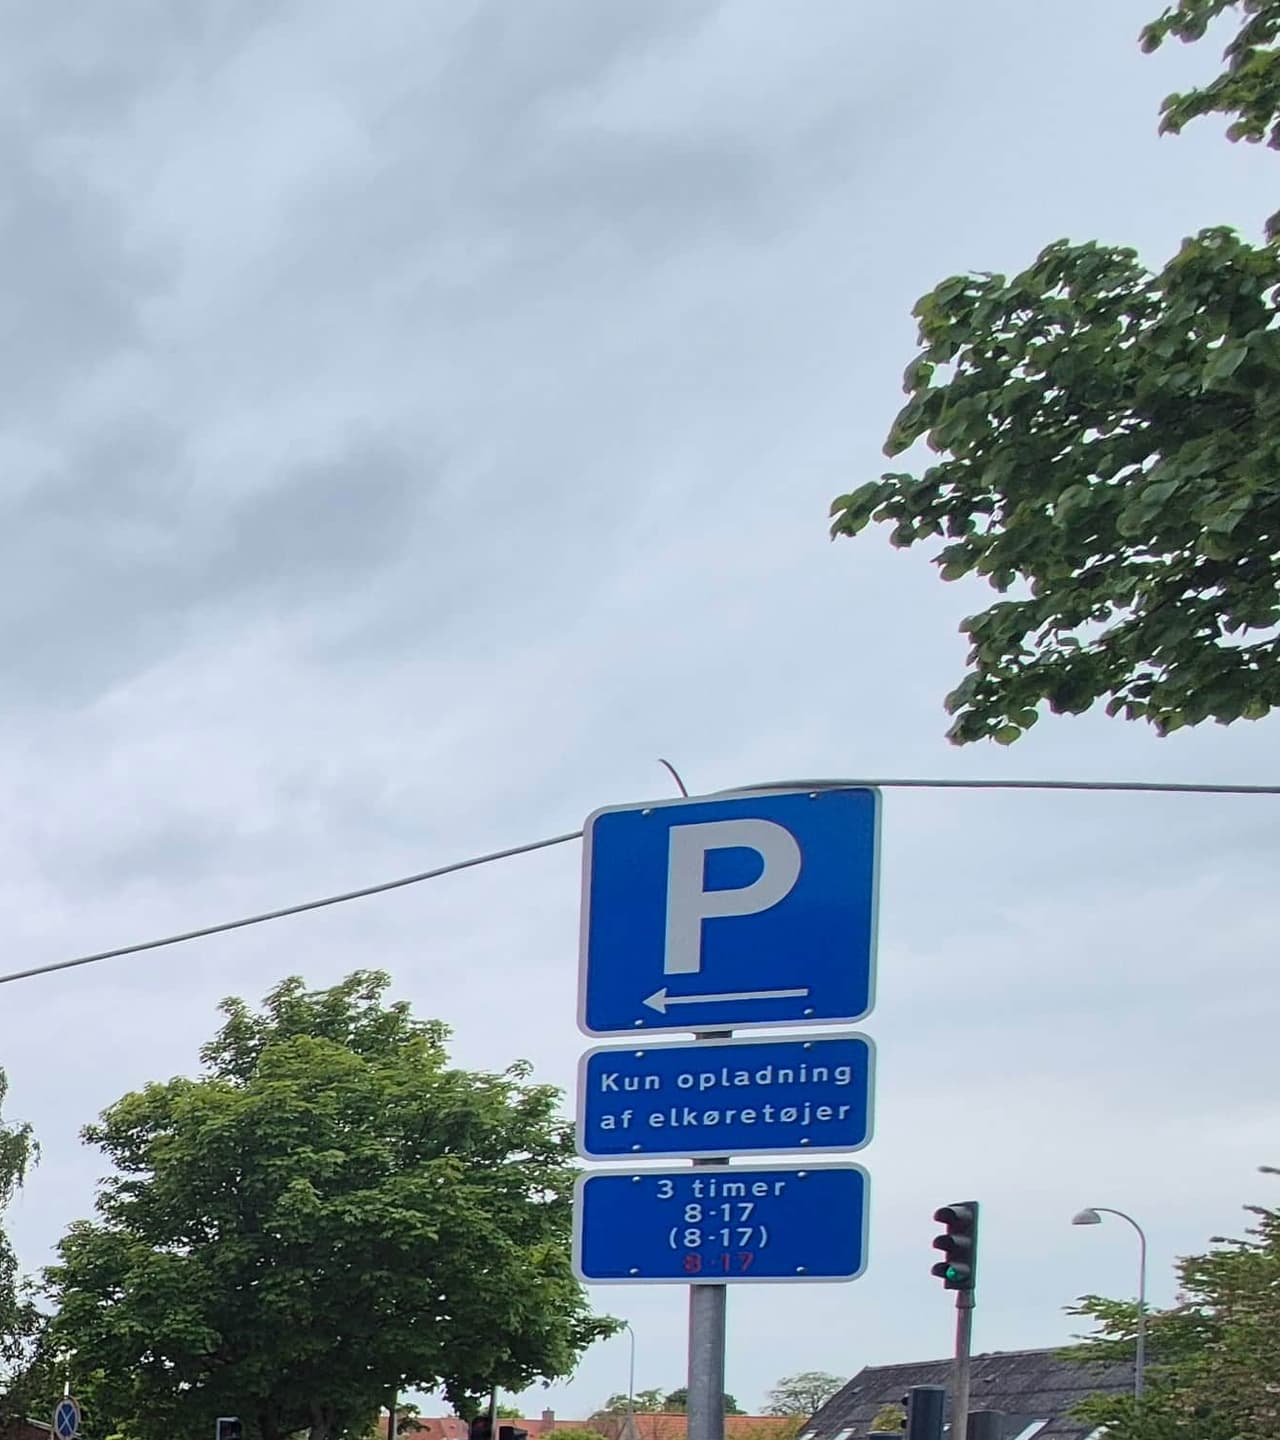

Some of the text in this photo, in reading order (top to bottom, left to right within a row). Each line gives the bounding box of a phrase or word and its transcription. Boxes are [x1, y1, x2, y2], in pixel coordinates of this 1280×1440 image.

[663, 818, 803, 975] P
[601, 1064, 852, 1092] Kun opladning
[600, 1102, 851, 1130] af elkøretøjer
[656, 1179, 786, 1198] 3 timer
[684, 1203, 755, 1223] 8-17
[669, 1225, 768, 1249] (8-17)
[683, 1252, 754, 1273] 8-17
